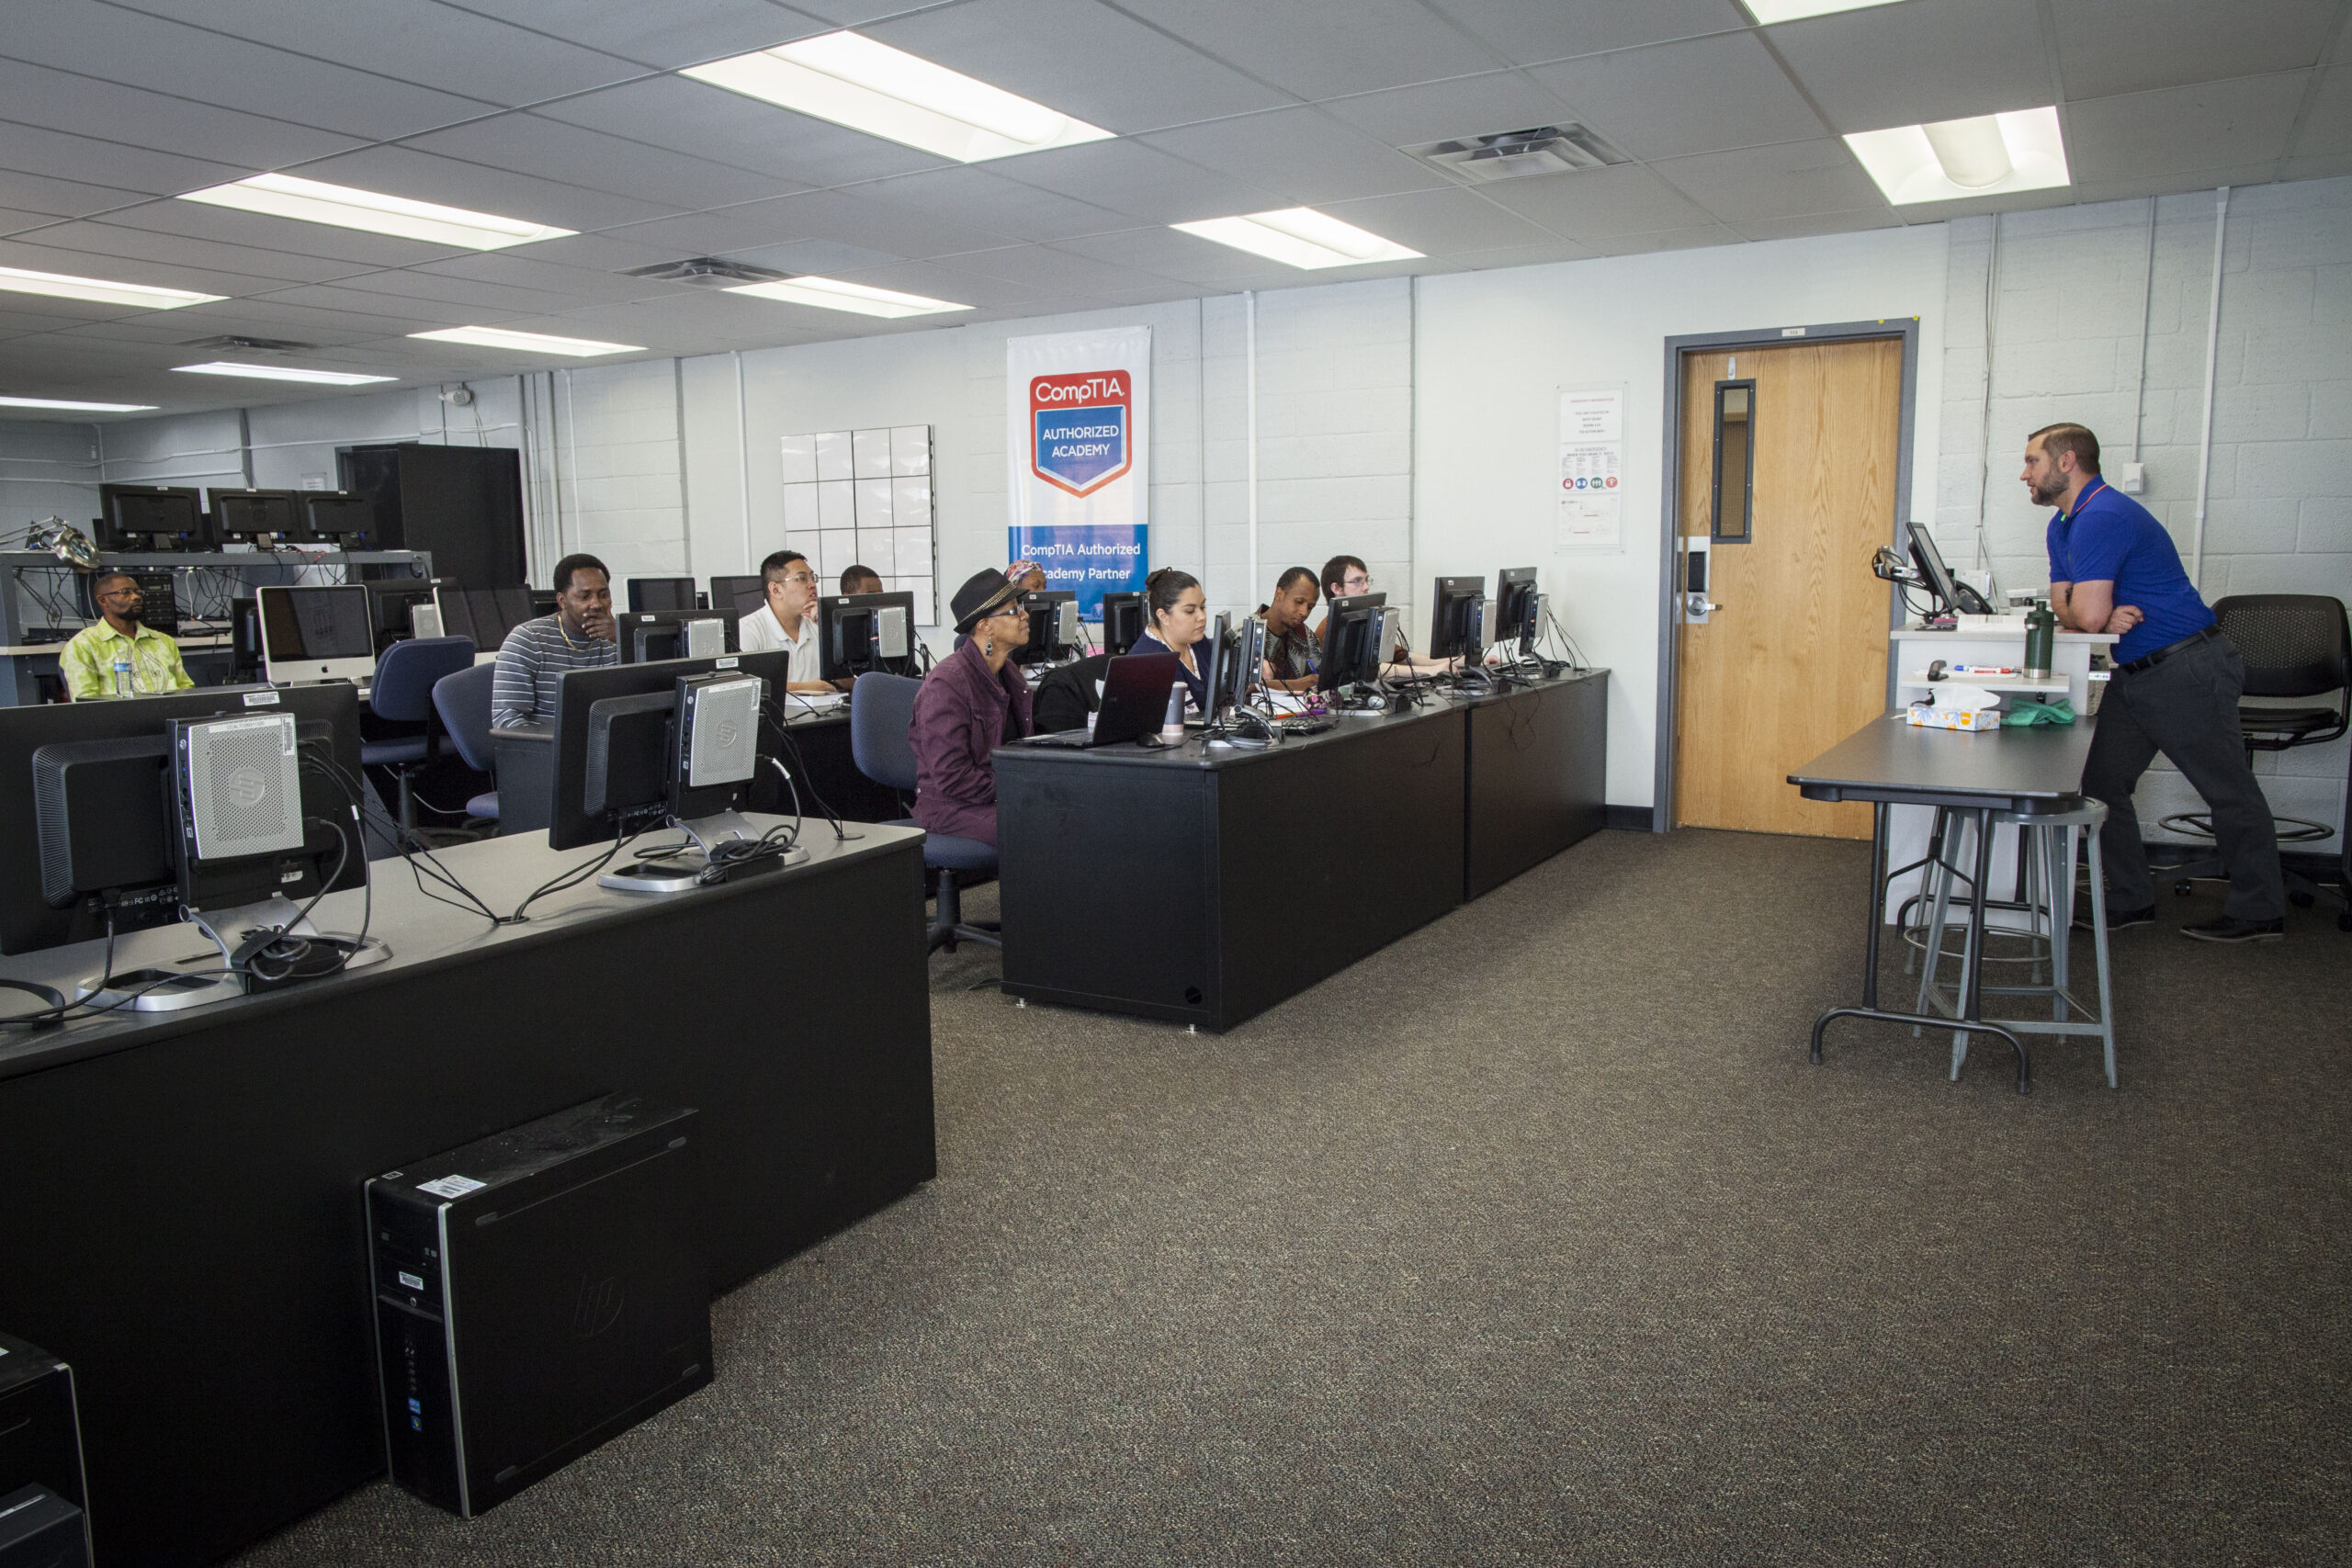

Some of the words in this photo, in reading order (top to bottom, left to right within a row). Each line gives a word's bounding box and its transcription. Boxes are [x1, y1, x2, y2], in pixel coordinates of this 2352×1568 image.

[1043, 425, 1119, 440] AUTHORIZED
[1051, 444, 1110, 457] ACADEMY
[1022, 544, 1074, 558] CompTIA
[1077, 543, 1141, 556] Authorized
[1088, 568, 1131, 580] Partner
